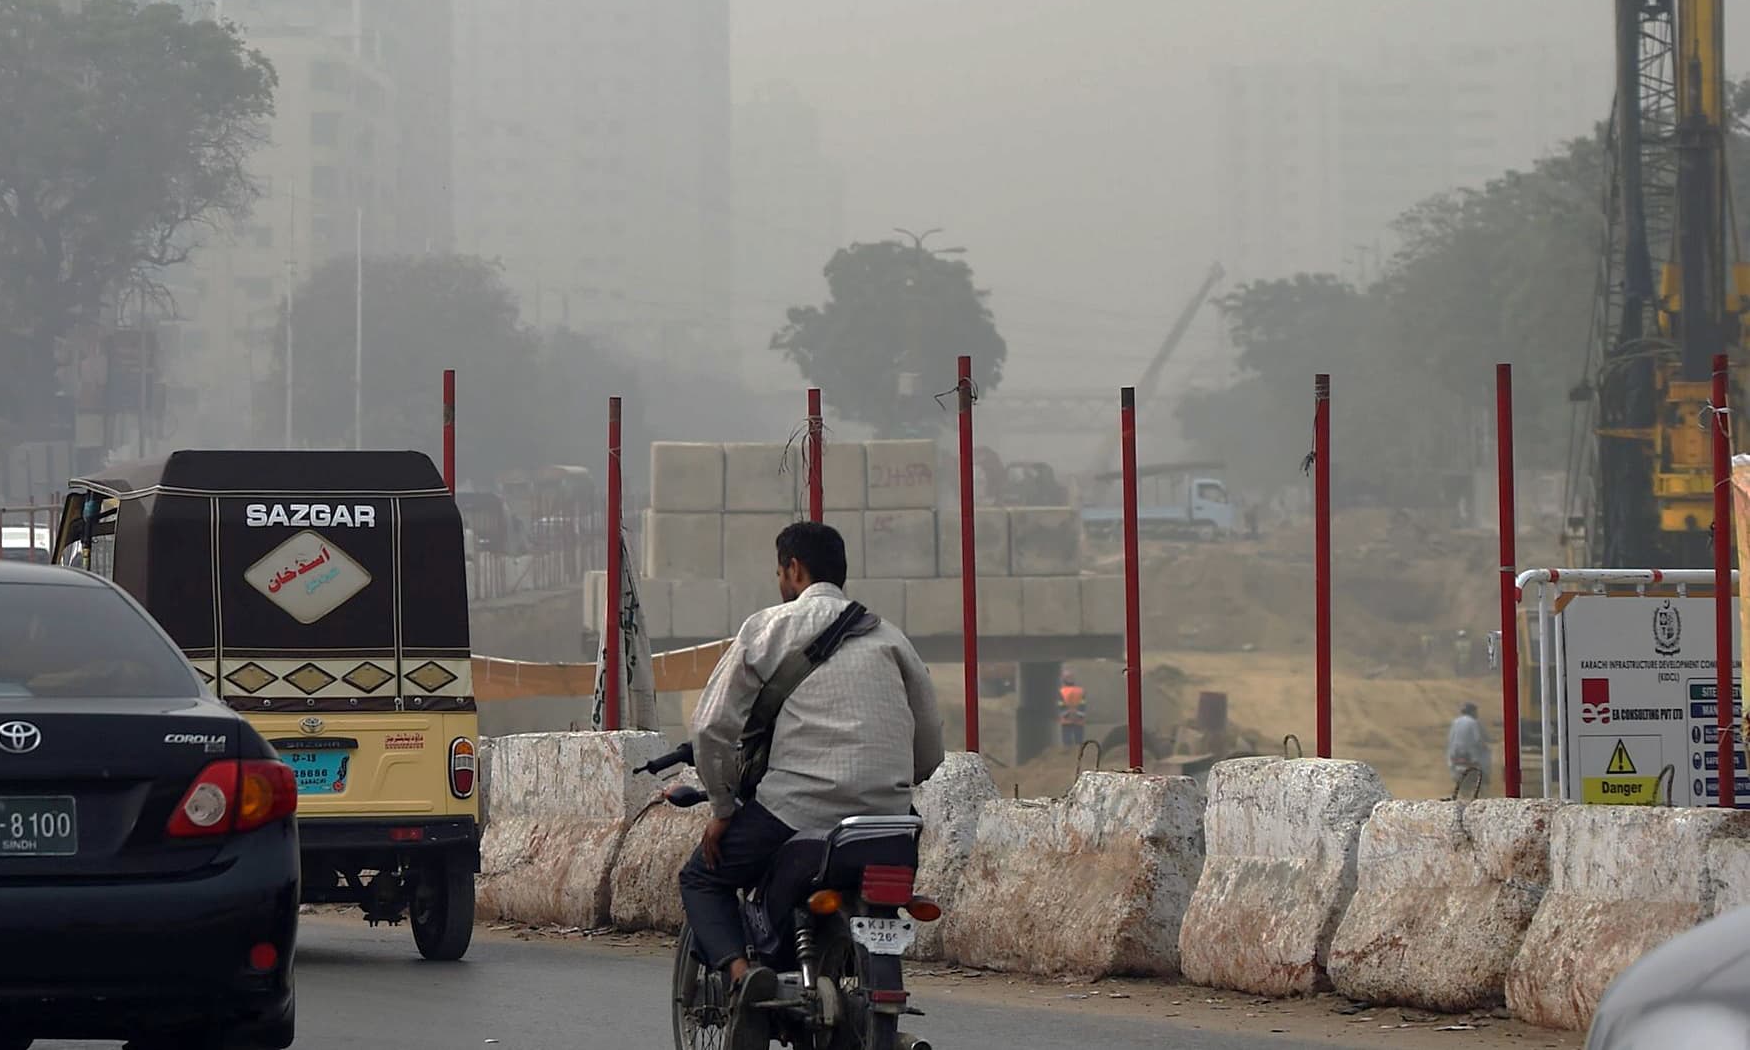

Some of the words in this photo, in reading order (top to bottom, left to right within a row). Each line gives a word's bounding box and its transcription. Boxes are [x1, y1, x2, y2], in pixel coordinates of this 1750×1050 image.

[246, 504, 376, 527] SAZGAR
[1581, 661, 1608, 669] KARACHI
[1621, 709, 1660, 720] CONSULTING
[1661, 709, 1672, 720] PVT
[164, 734, 226, 744] COROLLA
[1602, 781, 1642, 797] Danger
[2, 841, 37, 850] SINDH
